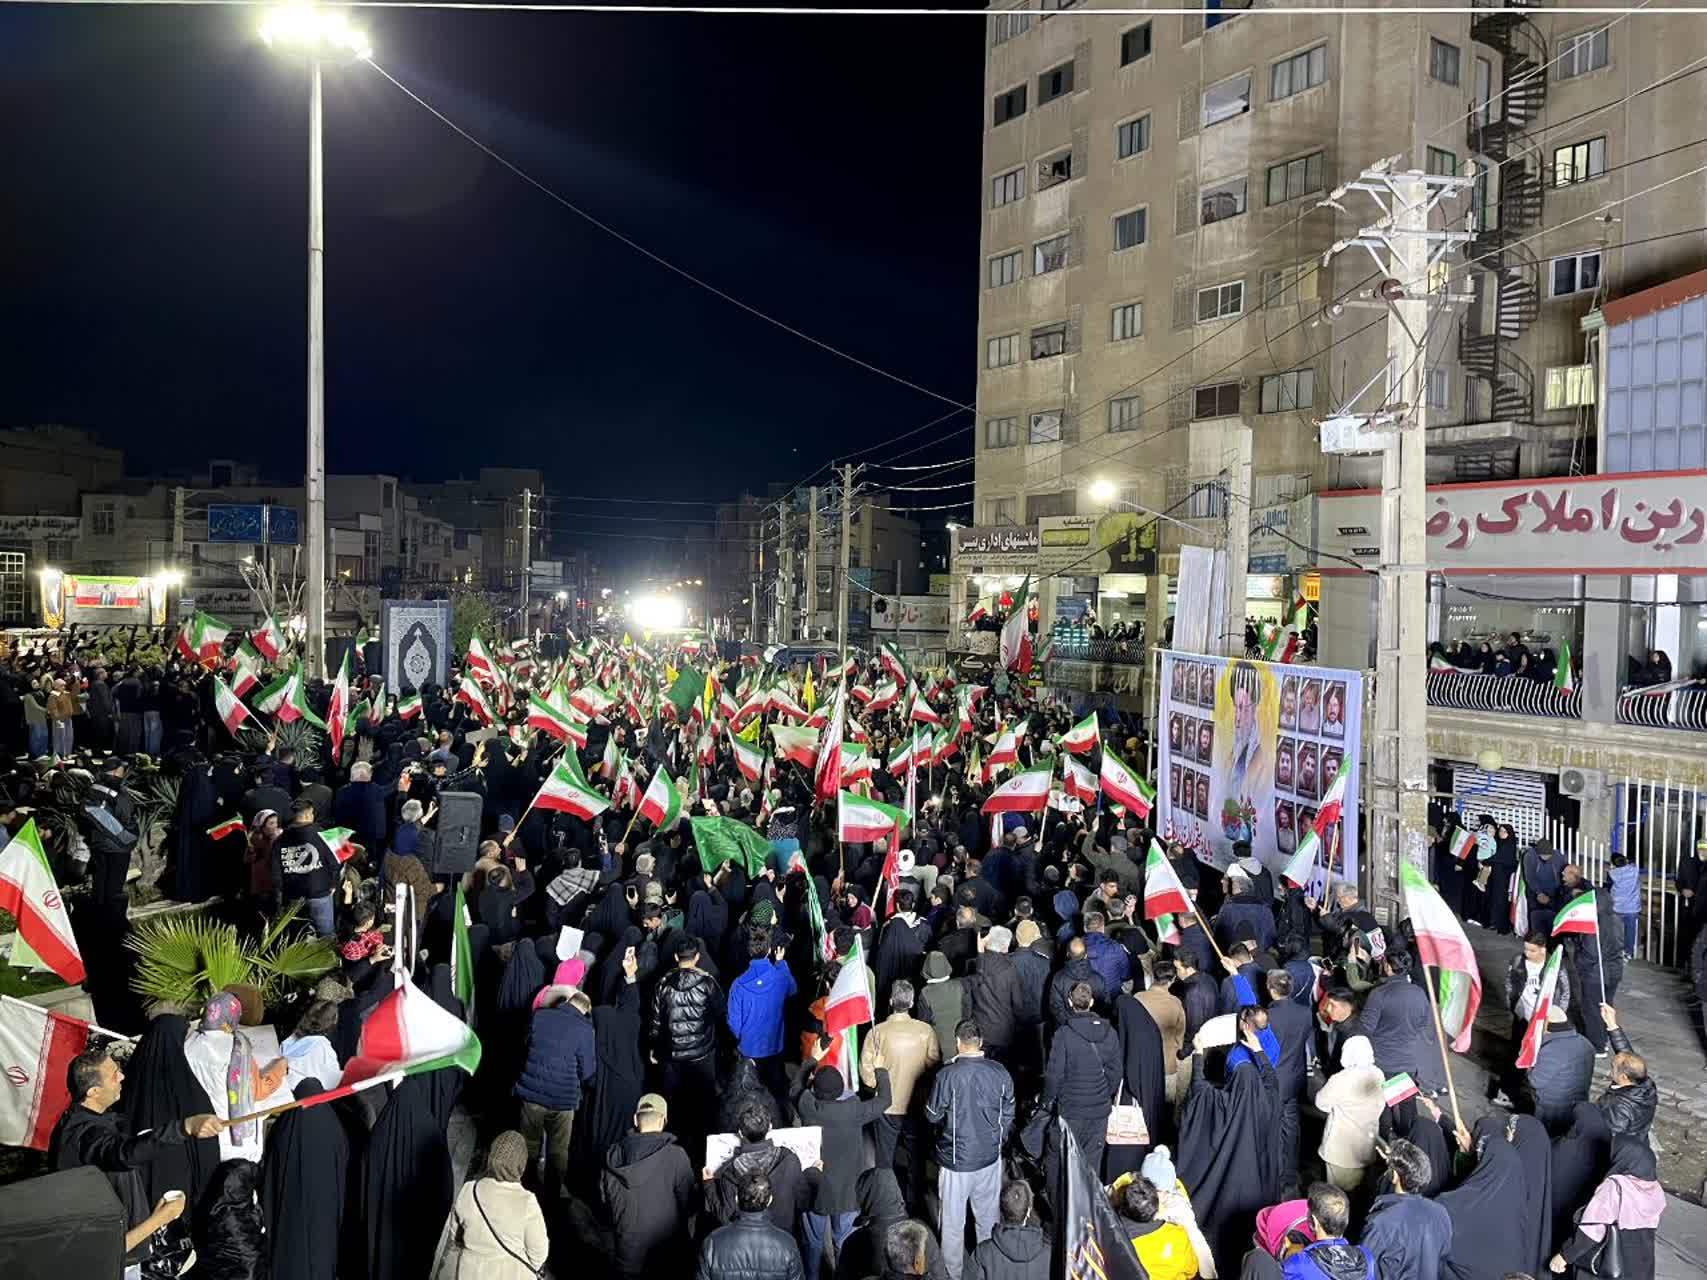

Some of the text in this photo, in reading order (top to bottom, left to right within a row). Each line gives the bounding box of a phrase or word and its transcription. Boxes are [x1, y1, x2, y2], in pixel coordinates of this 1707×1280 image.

[1425, 496, 1471, 549] رض
[1477, 487, 1618, 533] املاک
[978, 532, 1001, 552] اداری
